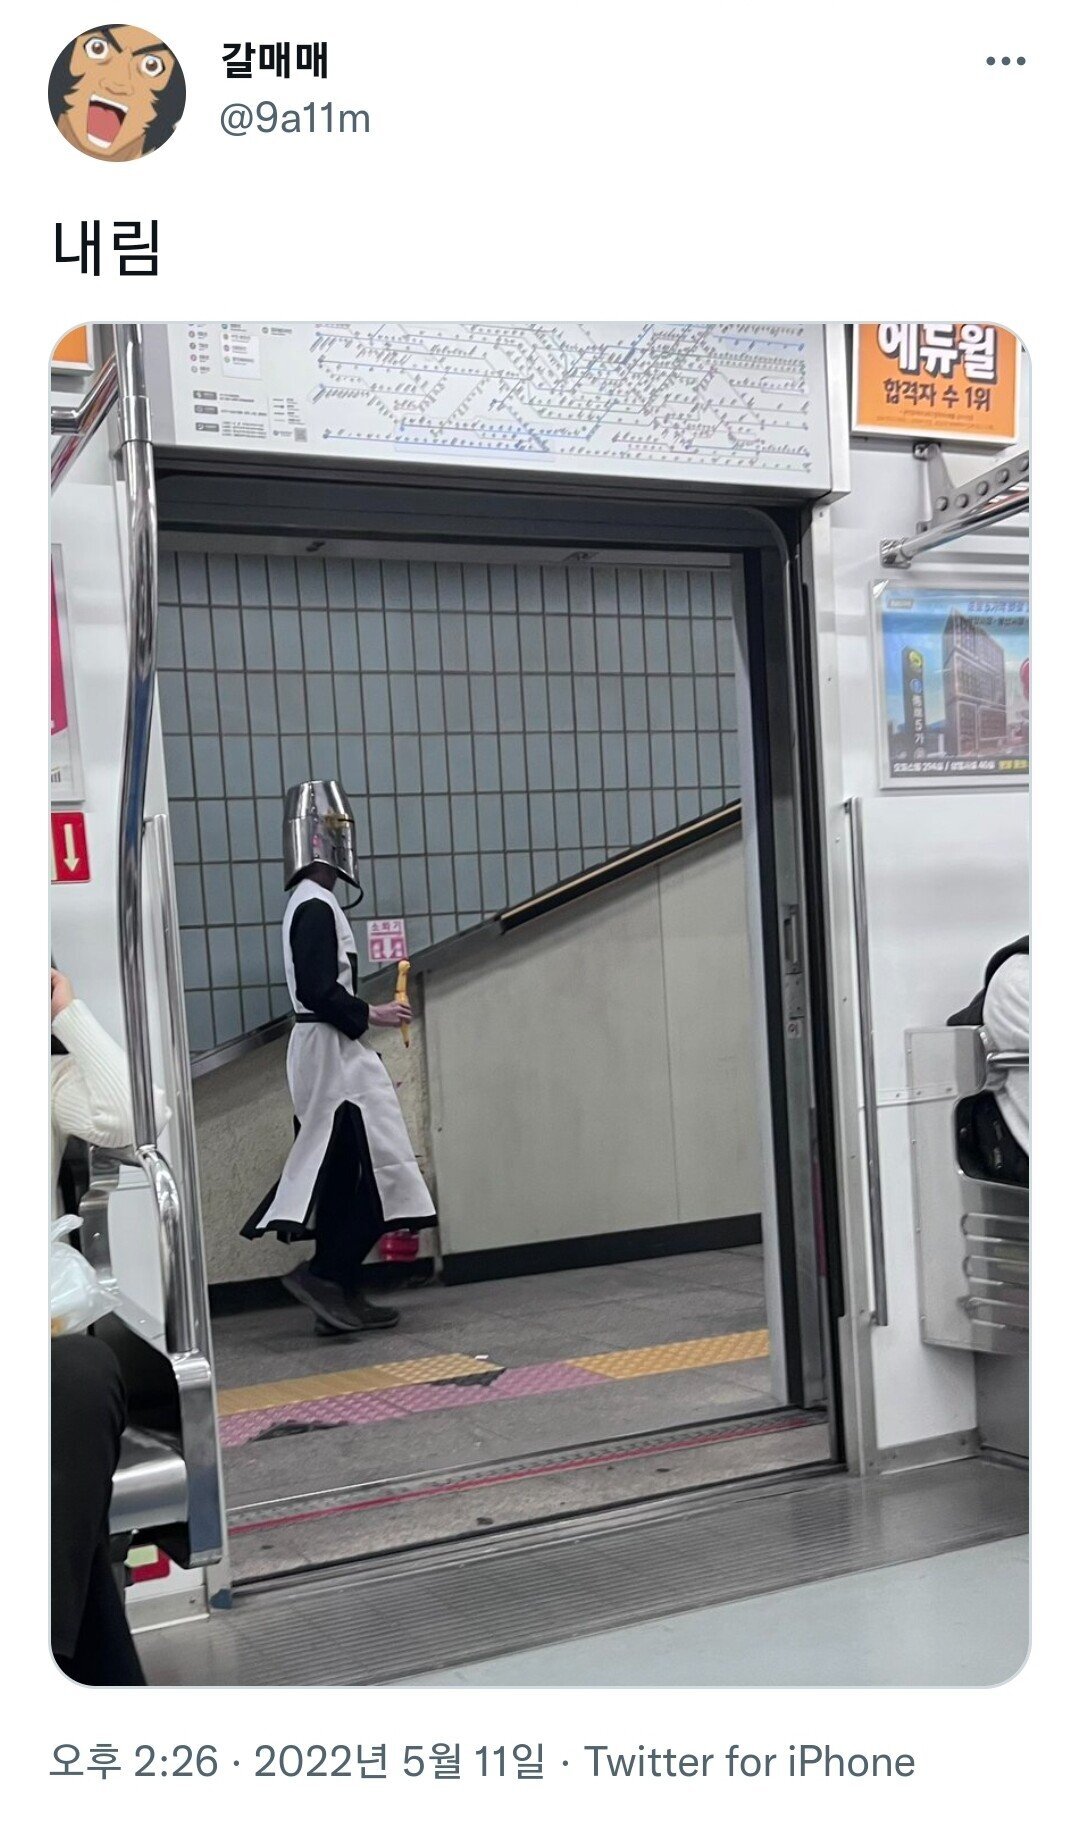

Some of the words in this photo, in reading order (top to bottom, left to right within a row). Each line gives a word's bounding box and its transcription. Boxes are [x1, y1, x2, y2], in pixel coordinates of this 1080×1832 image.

[877, 324, 997, 382] 에듀윌
[883, 378, 937, 407] 합격자
[941, 384, 960, 409] 수
[965, 386, 991, 412] 1위
